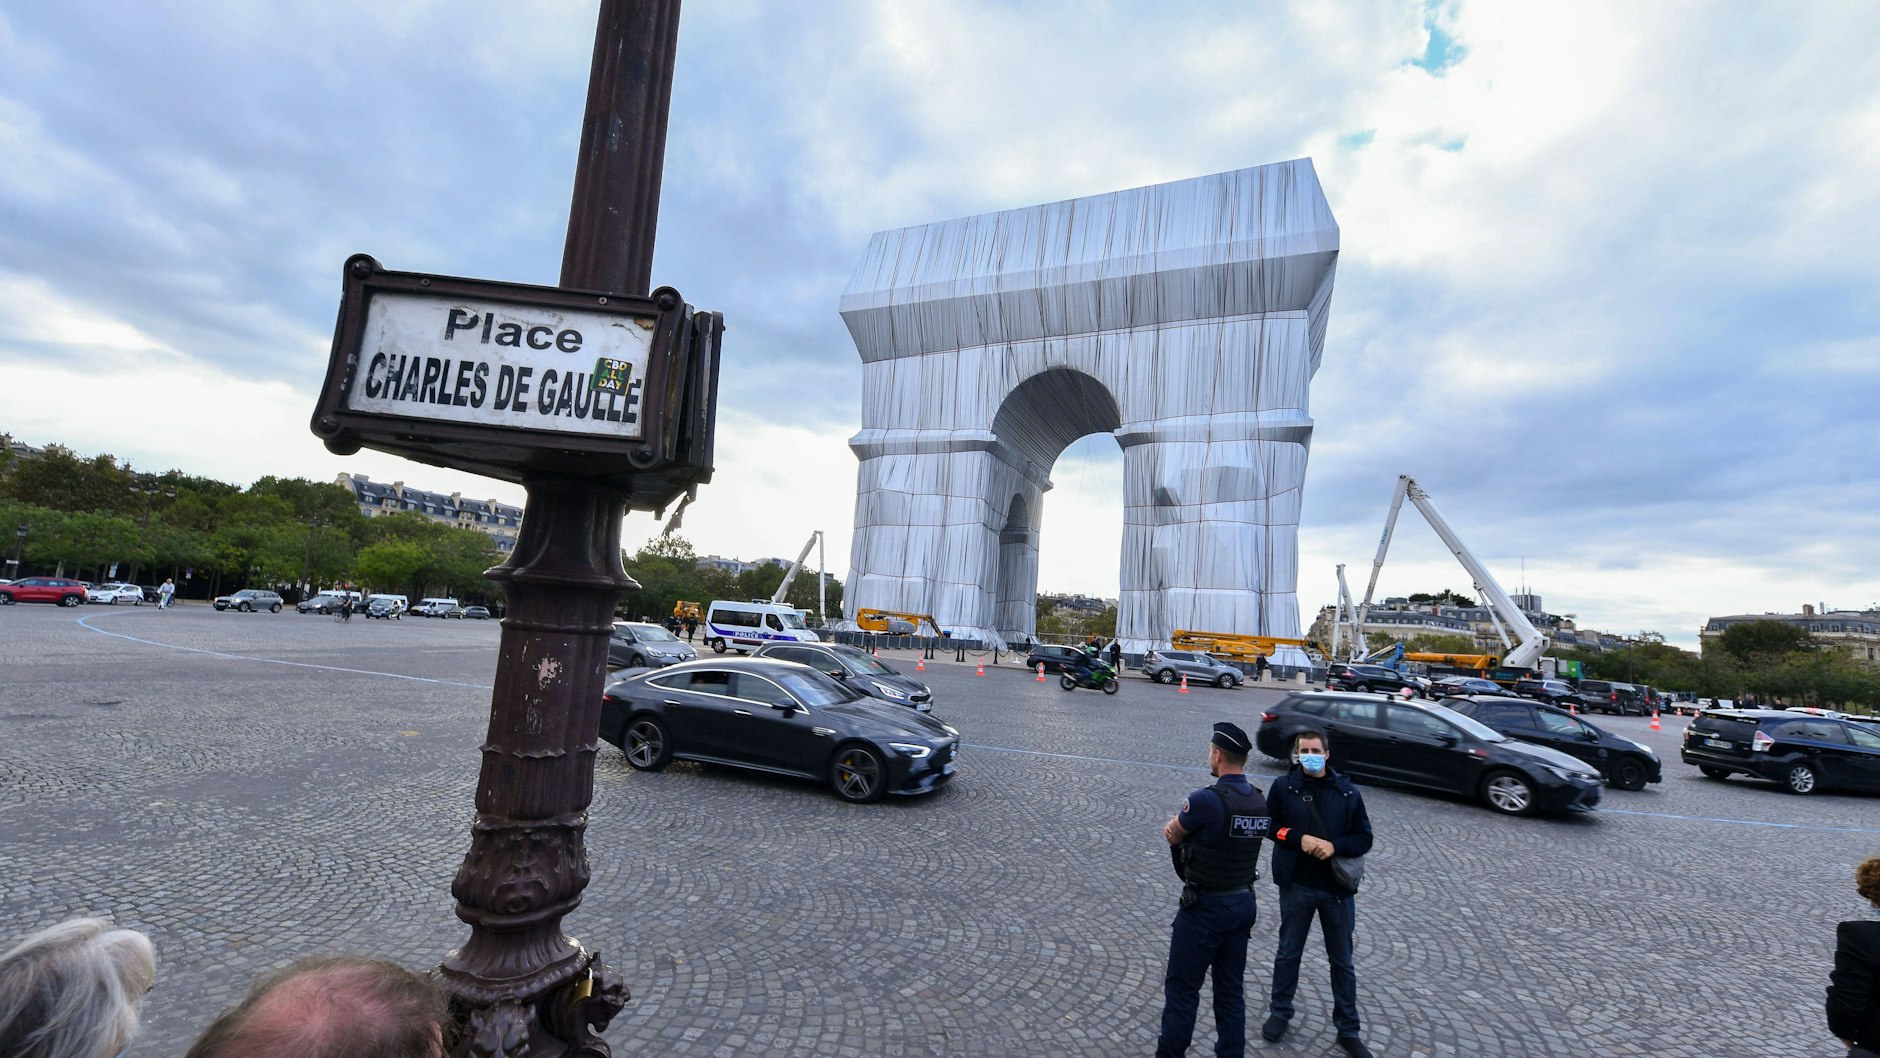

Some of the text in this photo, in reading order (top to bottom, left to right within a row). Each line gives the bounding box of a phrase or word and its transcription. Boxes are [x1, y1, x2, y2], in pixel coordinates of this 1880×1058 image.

[445, 308, 583, 353] Place
[604, 359, 628, 371] CBD
[602, 369, 624, 381] ALL
[366, 352, 642, 424] CHARLES DE GAULLE
[598, 378, 622, 390] DAY
[1234, 817, 1269, 829] POLICE
